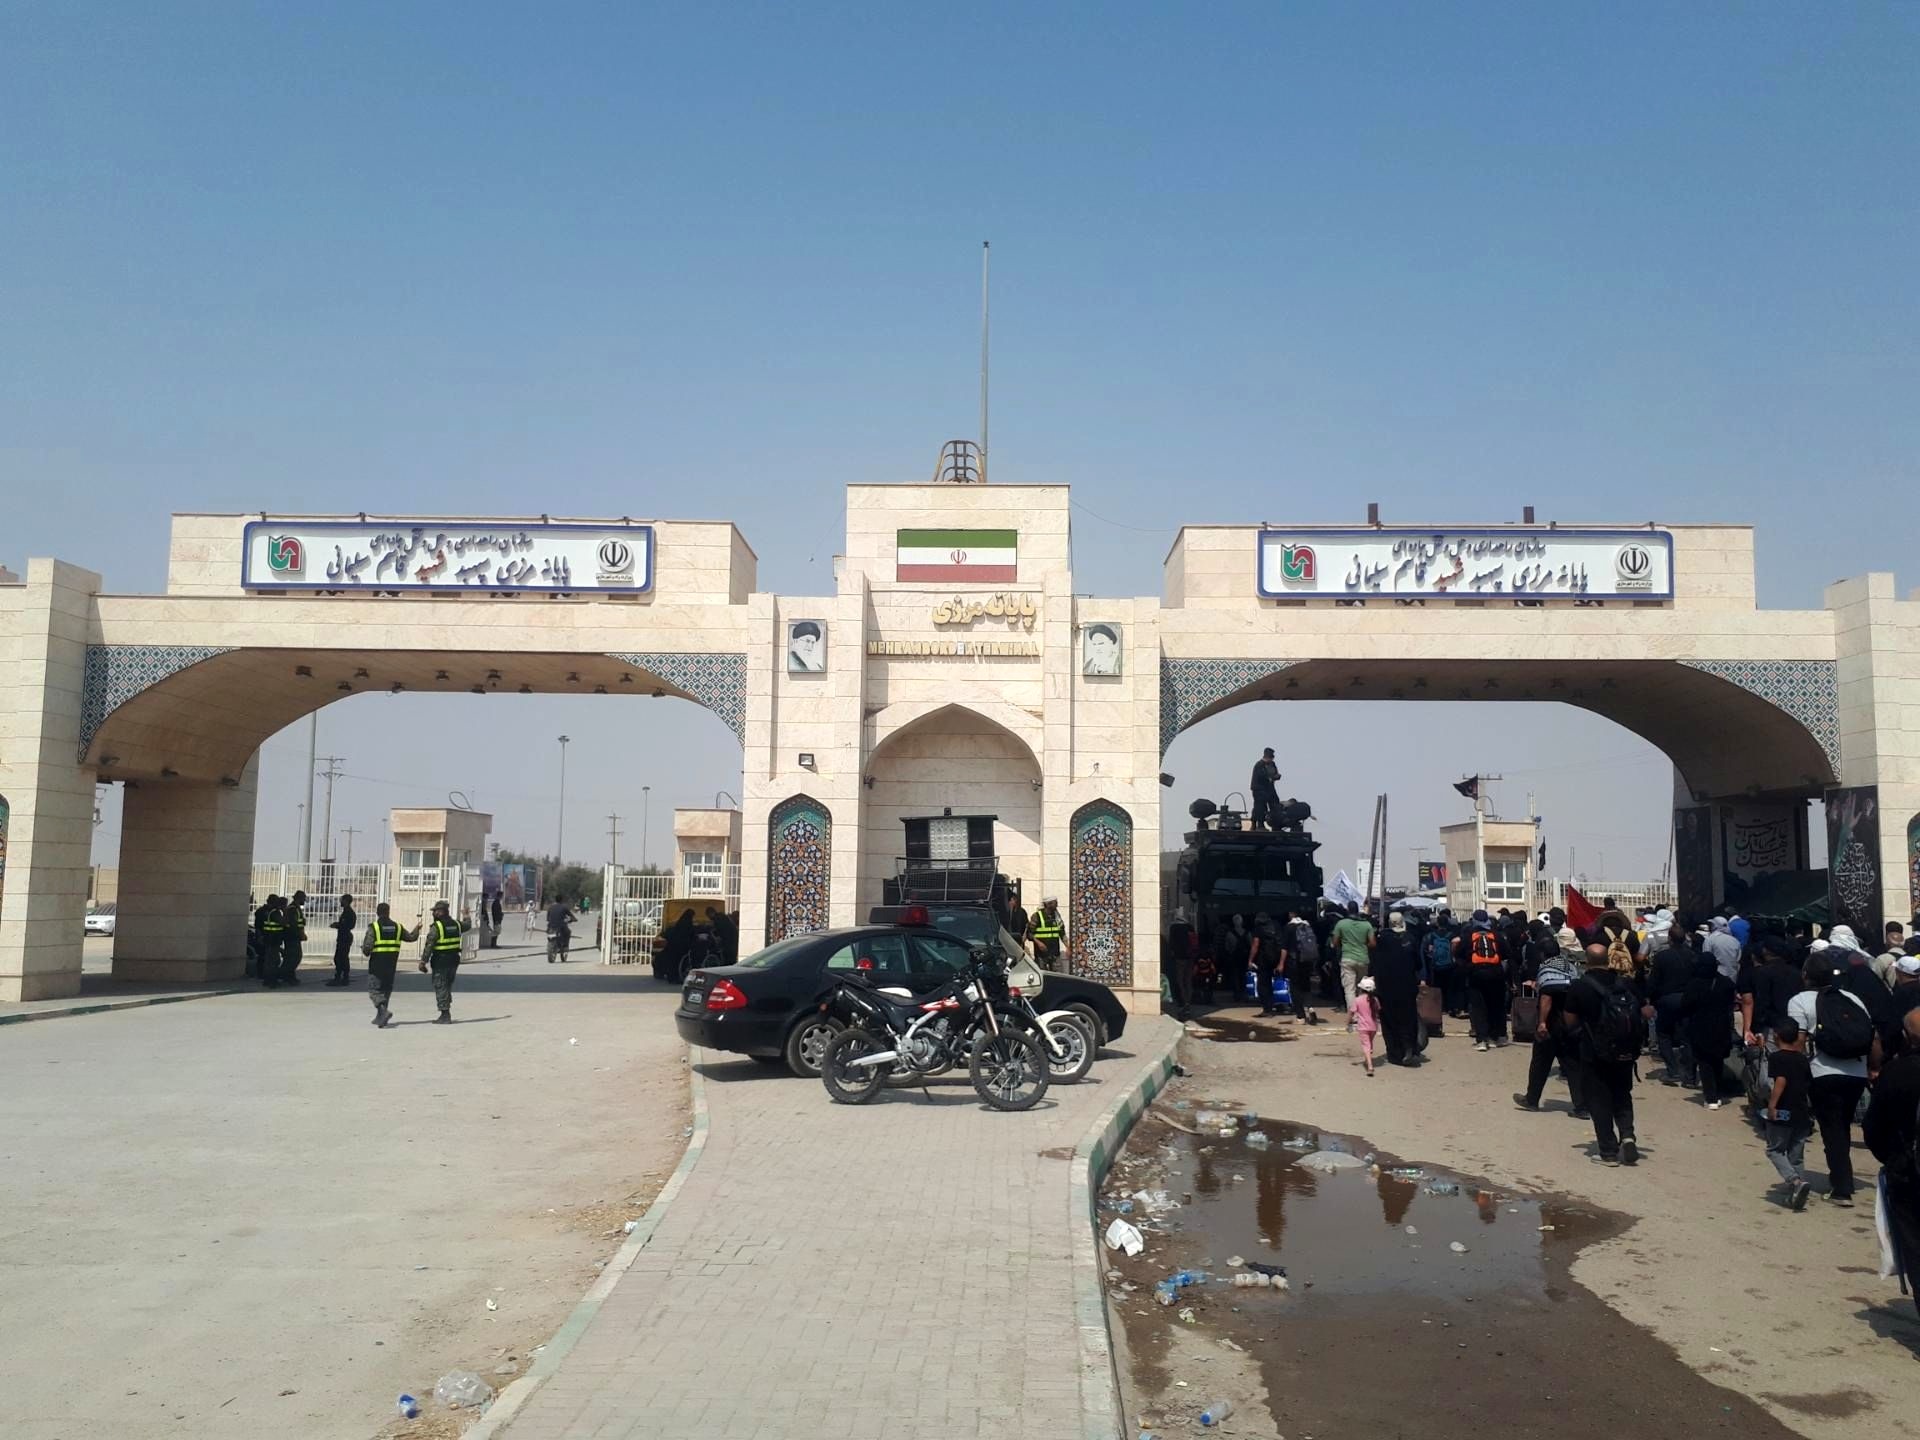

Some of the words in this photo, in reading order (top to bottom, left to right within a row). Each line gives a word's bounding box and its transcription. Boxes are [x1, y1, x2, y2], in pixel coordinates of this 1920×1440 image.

[327, 544, 371, 580] سلیمانی
[414, 549, 447, 581] شهید
[496, 557, 537, 583] مرزی
[541, 555, 571, 584] پایانه
[1345, 553, 1389, 590] سلیمانی
[1433, 556, 1465, 592] شهید
[1512, 563, 1553, 590] مرزی
[1557, 561, 1588, 592] پایانه
[932, 595, 985, 625] مرزی
[867, 640, 922, 656] MEHRAN
[974, 640, 1040, 656] TERMINAL
